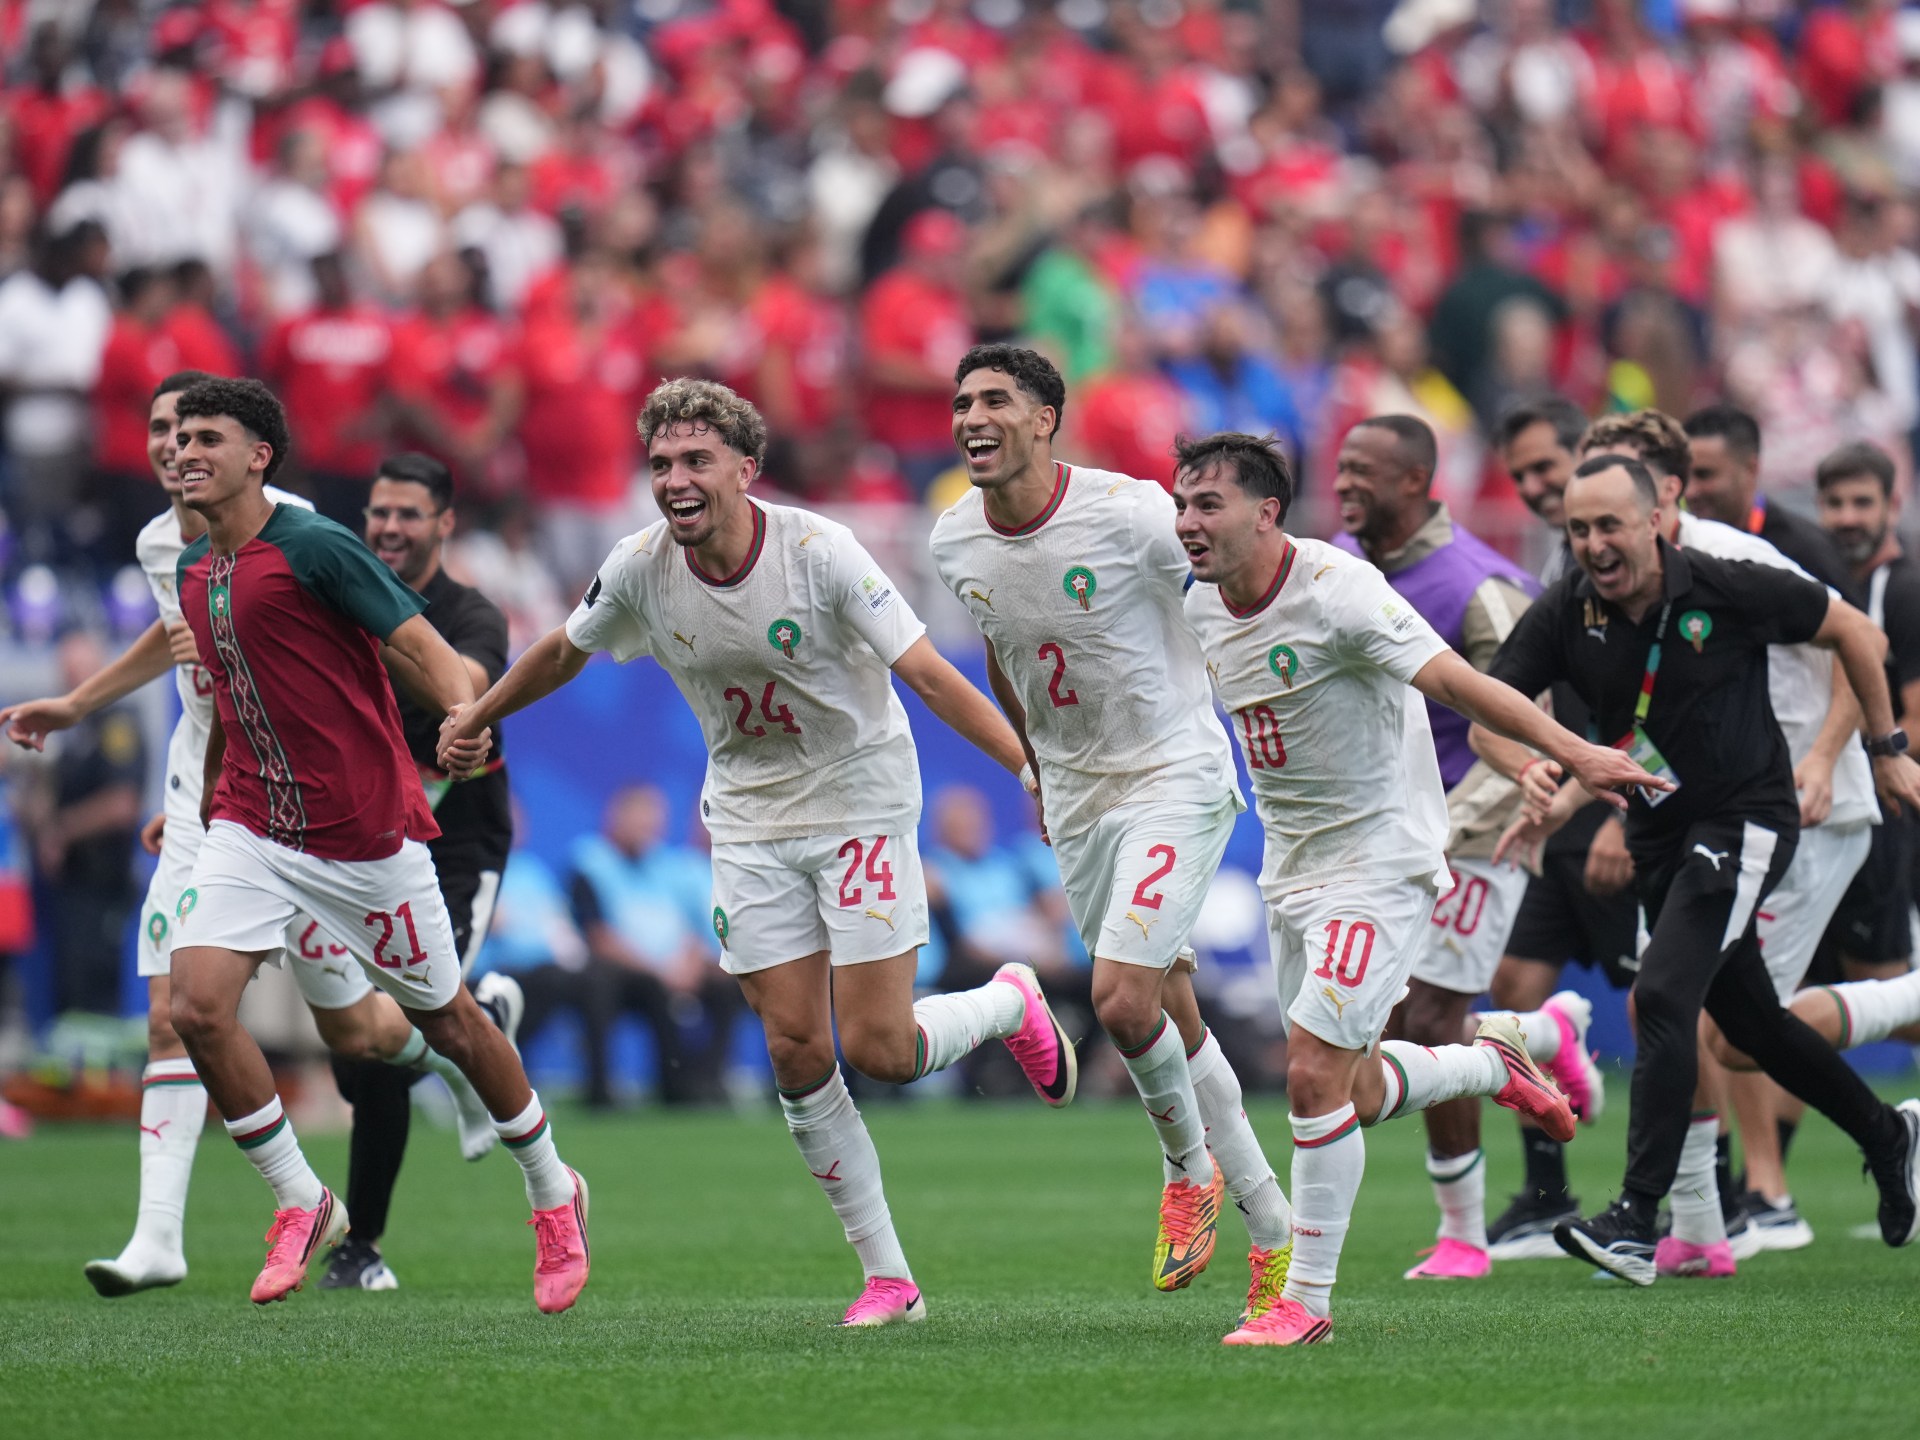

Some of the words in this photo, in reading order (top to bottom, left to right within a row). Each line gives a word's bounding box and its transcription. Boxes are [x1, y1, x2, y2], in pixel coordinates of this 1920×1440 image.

[870, 588, 891, 609] EDUCATION
[1038, 643, 1079, 708] 2
[724, 681, 801, 737] 24
[1236, 704, 1287, 769] 10
[838, 835, 896, 907] 24
[1131, 843, 1177, 910] 2
[1431, 870, 1489, 936] 20
[364, 901, 427, 968] 21
[1313, 919, 1376, 988] 10
